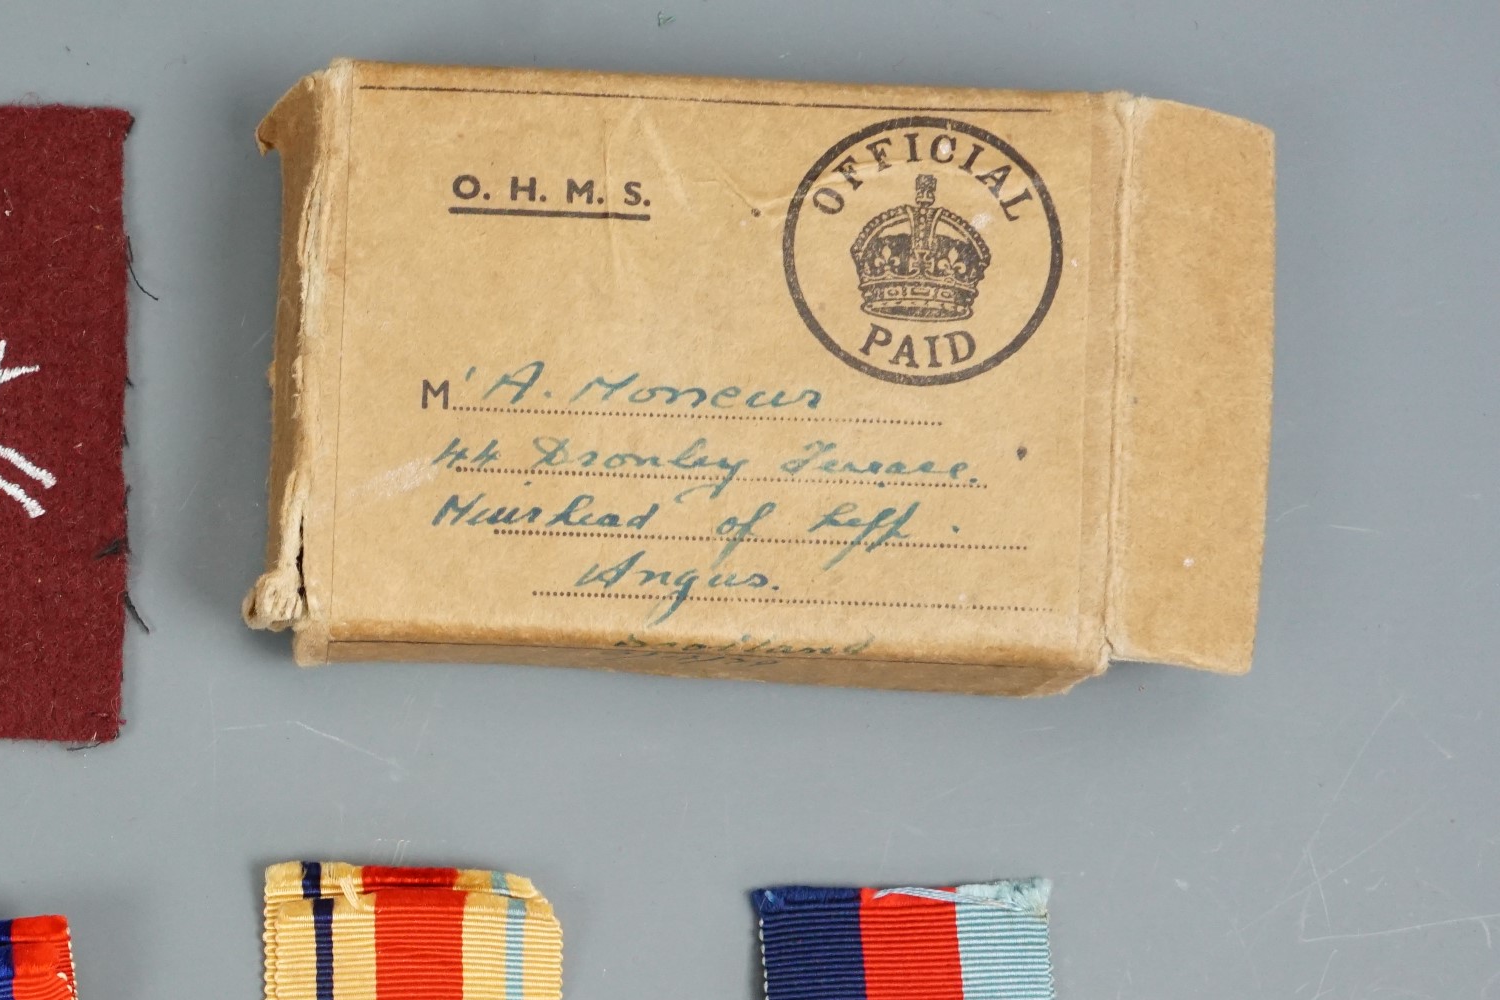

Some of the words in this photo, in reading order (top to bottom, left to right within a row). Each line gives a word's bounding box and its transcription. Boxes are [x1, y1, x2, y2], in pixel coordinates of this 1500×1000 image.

[812, 133, 1033, 222] OFFICIAL
[859, 323, 977, 368] PAID
[431, 437, 500, 466] 44
[712, 501, 777, 569] of
